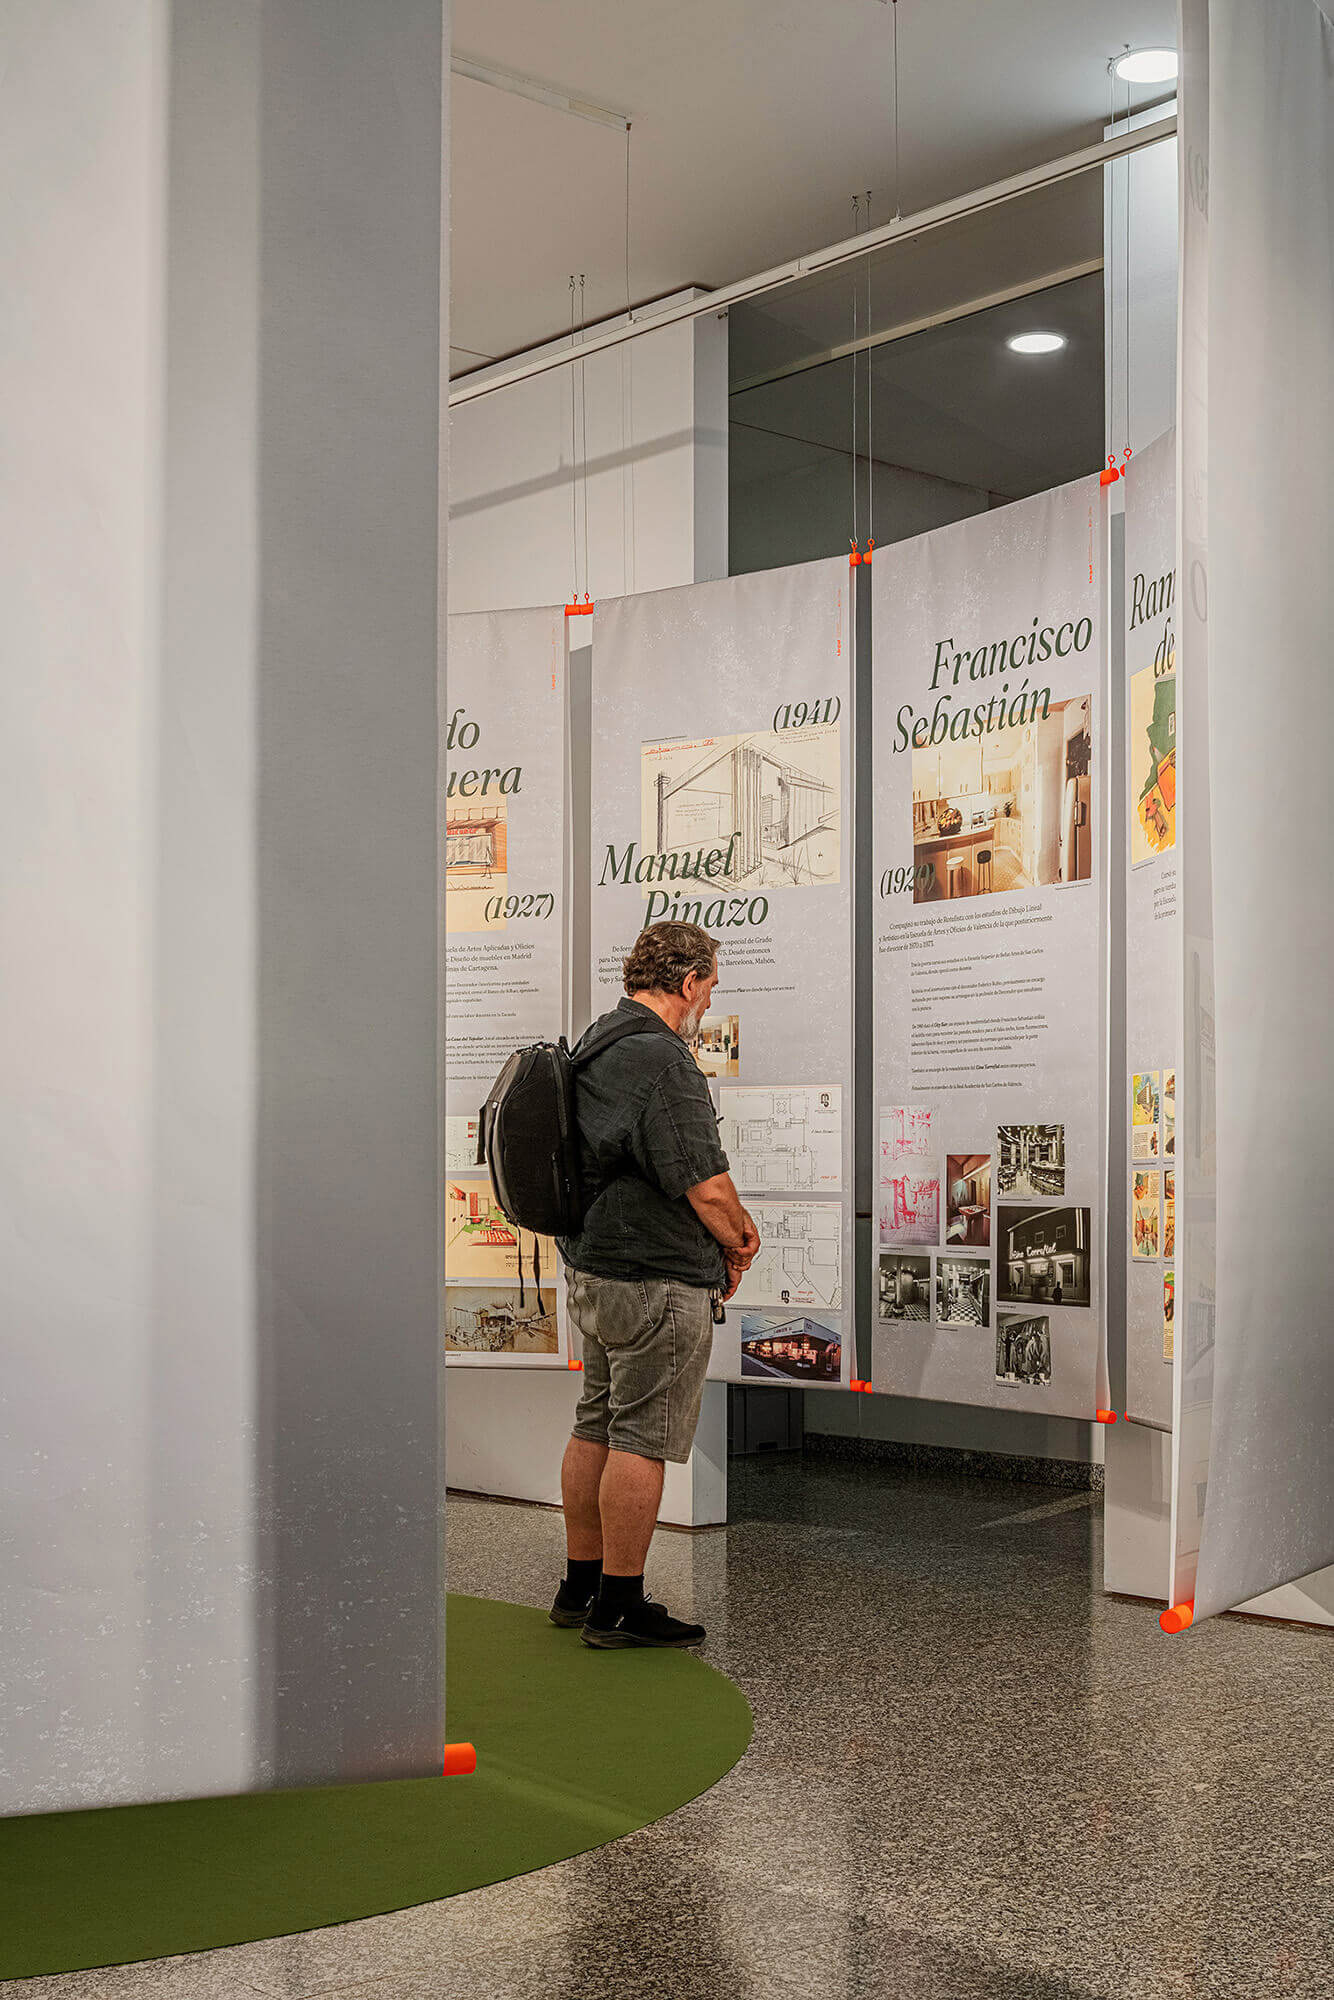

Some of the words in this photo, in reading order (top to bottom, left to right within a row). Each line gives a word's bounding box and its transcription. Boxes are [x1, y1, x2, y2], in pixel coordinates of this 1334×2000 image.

[928, 616, 1093, 691] Francisco
[773, 696, 842, 733] (1941)
[893, 678, 1051, 754] Sebastián
[597, 832, 742, 886] Manuel
[484, 892, 555, 922] (1927)
[640, 890, 769, 933] Pinazo
[937, 916, 943, 924] de
[1002, 907, 1008, 915] de
[466, 944, 482, 952] Artes
[483, 943, 510, 952] Aplicadas
[512, 952, 532, 960] Madrid
[725, 937, 747, 946] especial
[755, 936, 773, 944] Grado
[728, 948, 745, 956] Desde
